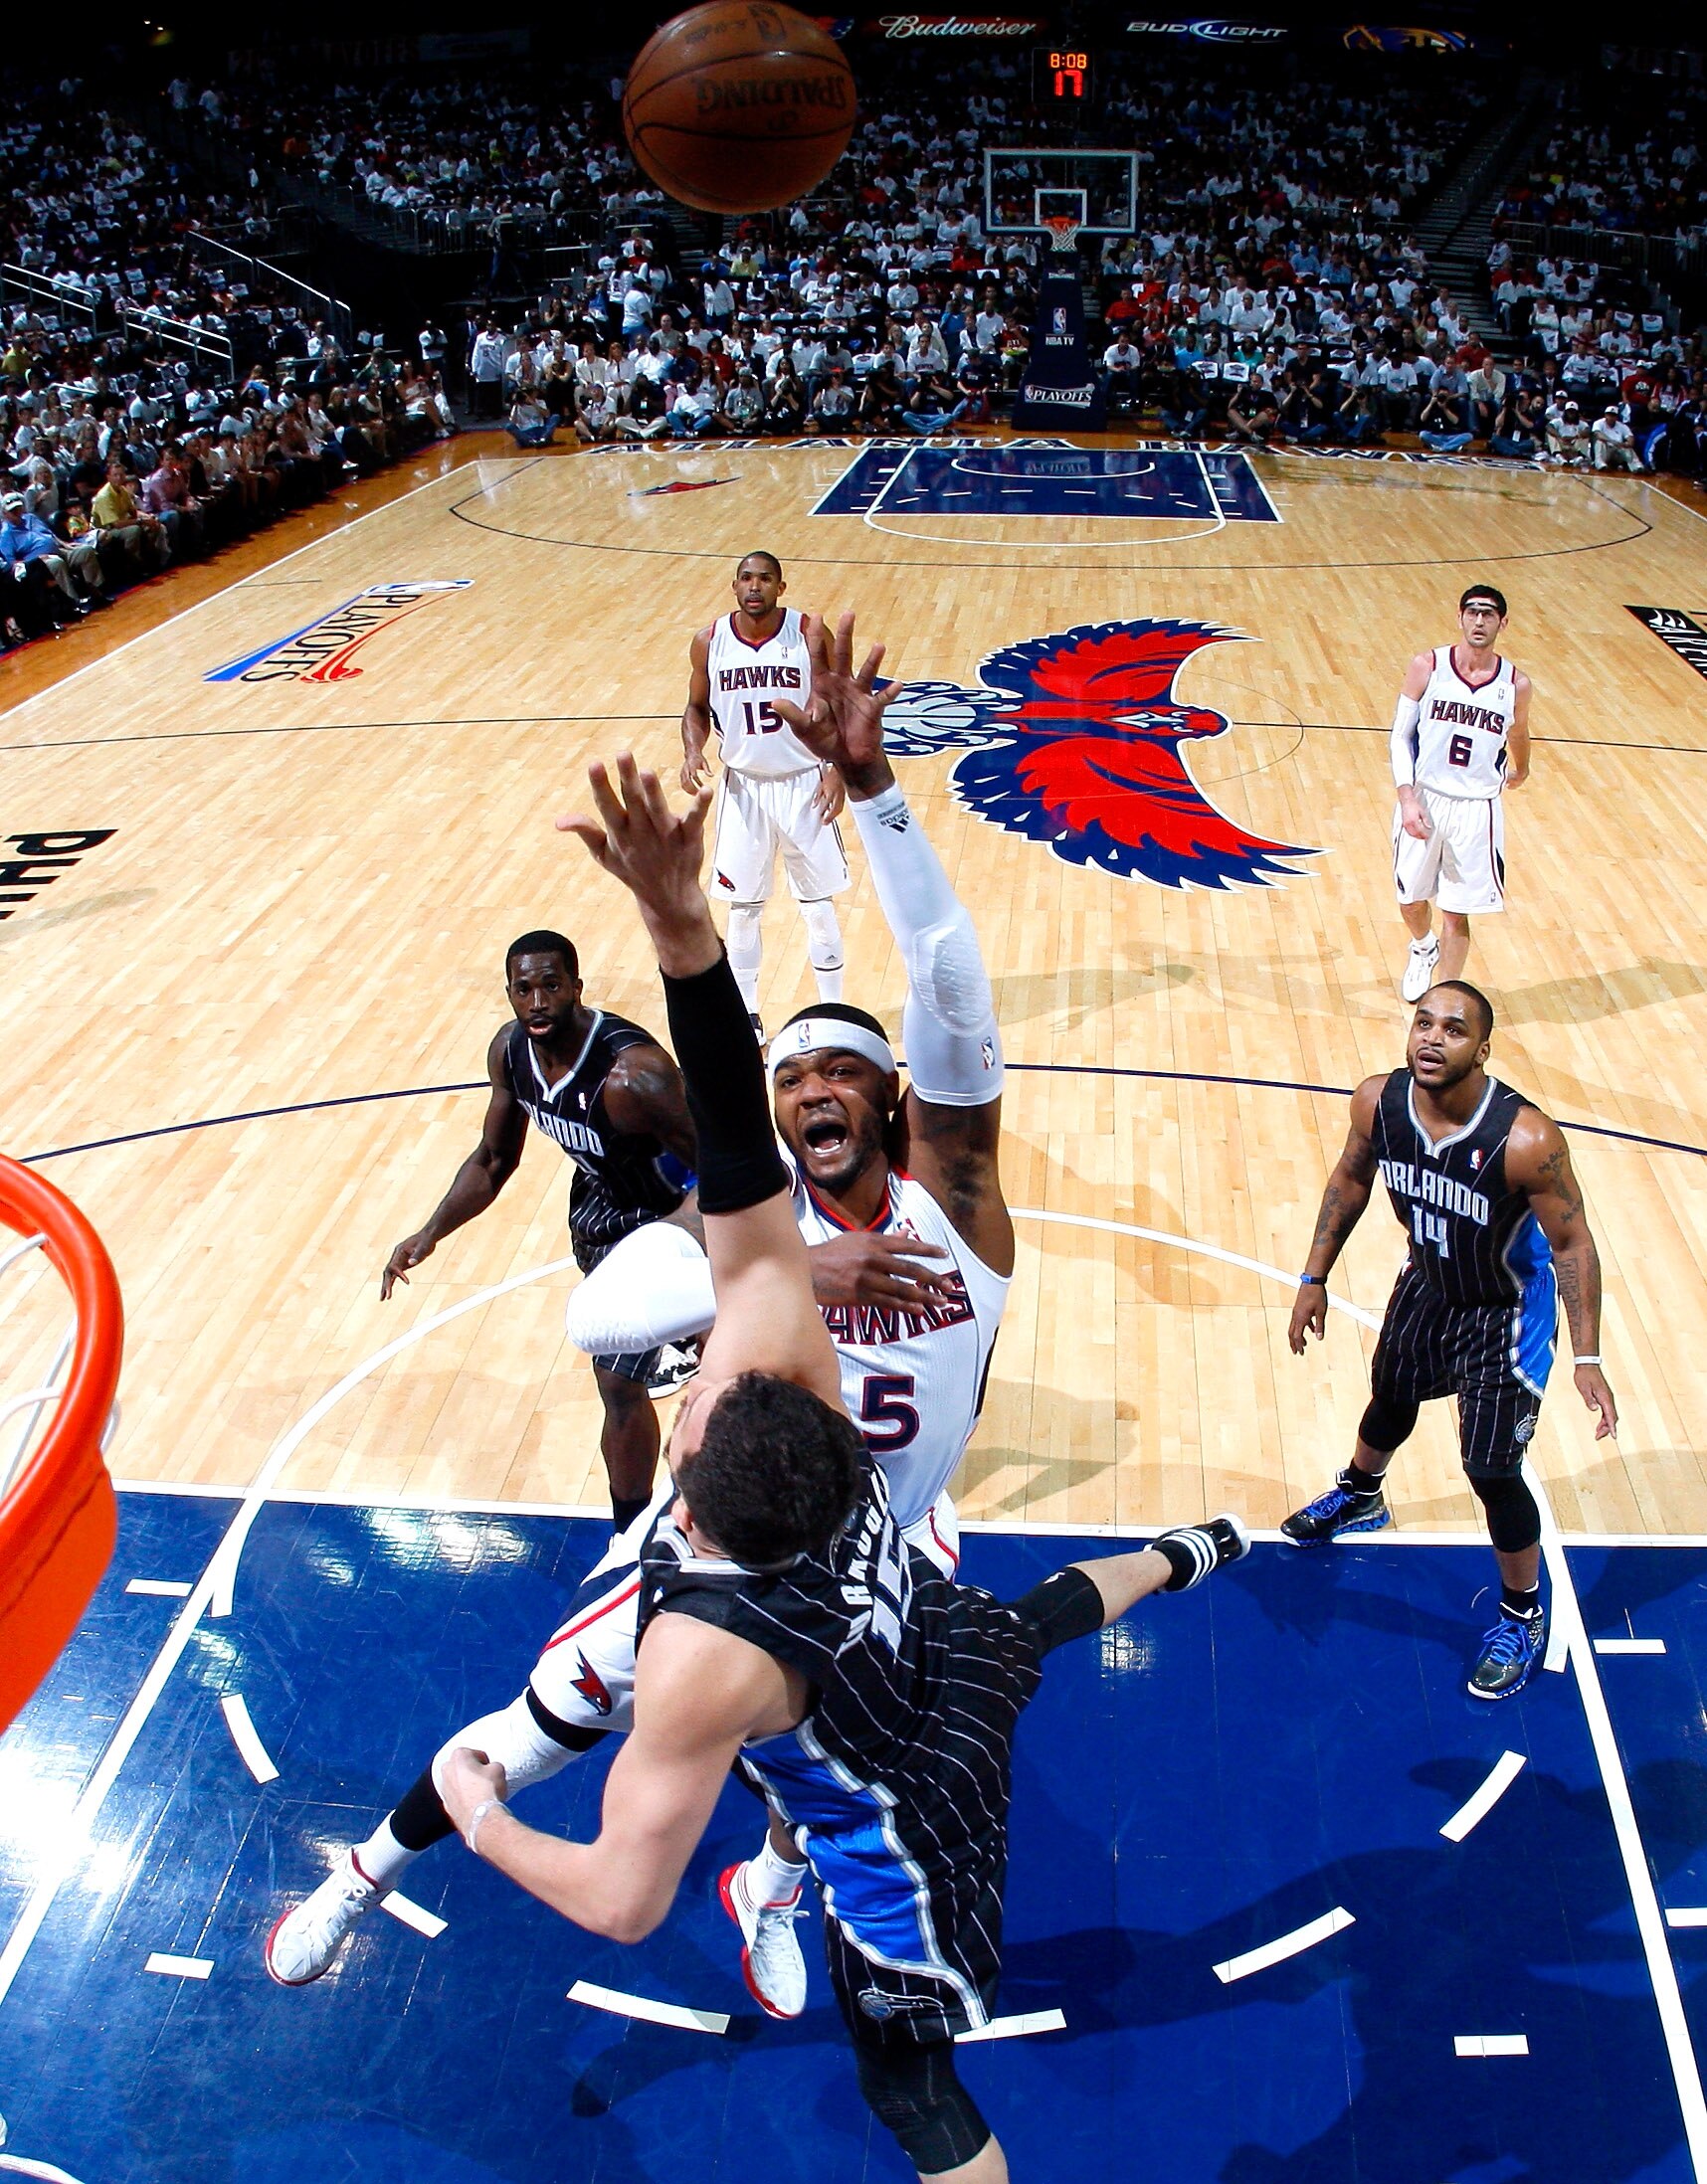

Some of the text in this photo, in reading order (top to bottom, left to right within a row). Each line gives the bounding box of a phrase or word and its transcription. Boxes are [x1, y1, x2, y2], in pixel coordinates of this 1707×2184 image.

[878, 15, 1037, 38] Budweiser
[1127, 21, 1288, 38] BUD LIGHT
[1049, 53, 1087, 69] 8:08
[696, 77, 847, 116] SPALDING
[1054, 70, 1083, 96] 17
[1044, 336, 1075, 346] NBA TV
[1033, 388, 1093, 402] PLAYOFFS
[241, 594, 425, 682] PLAYOFFS
[718, 665, 802, 692] HAWKS
[742, 699, 784, 735] 15
[1429, 699, 1506, 736] HAWKS
[1448, 734, 1474, 768] 6
[1378, 1159, 1489, 1226] ORLANDO
[1412, 1203, 1449, 1258] 14
[860, 1375, 921, 1454] 5
